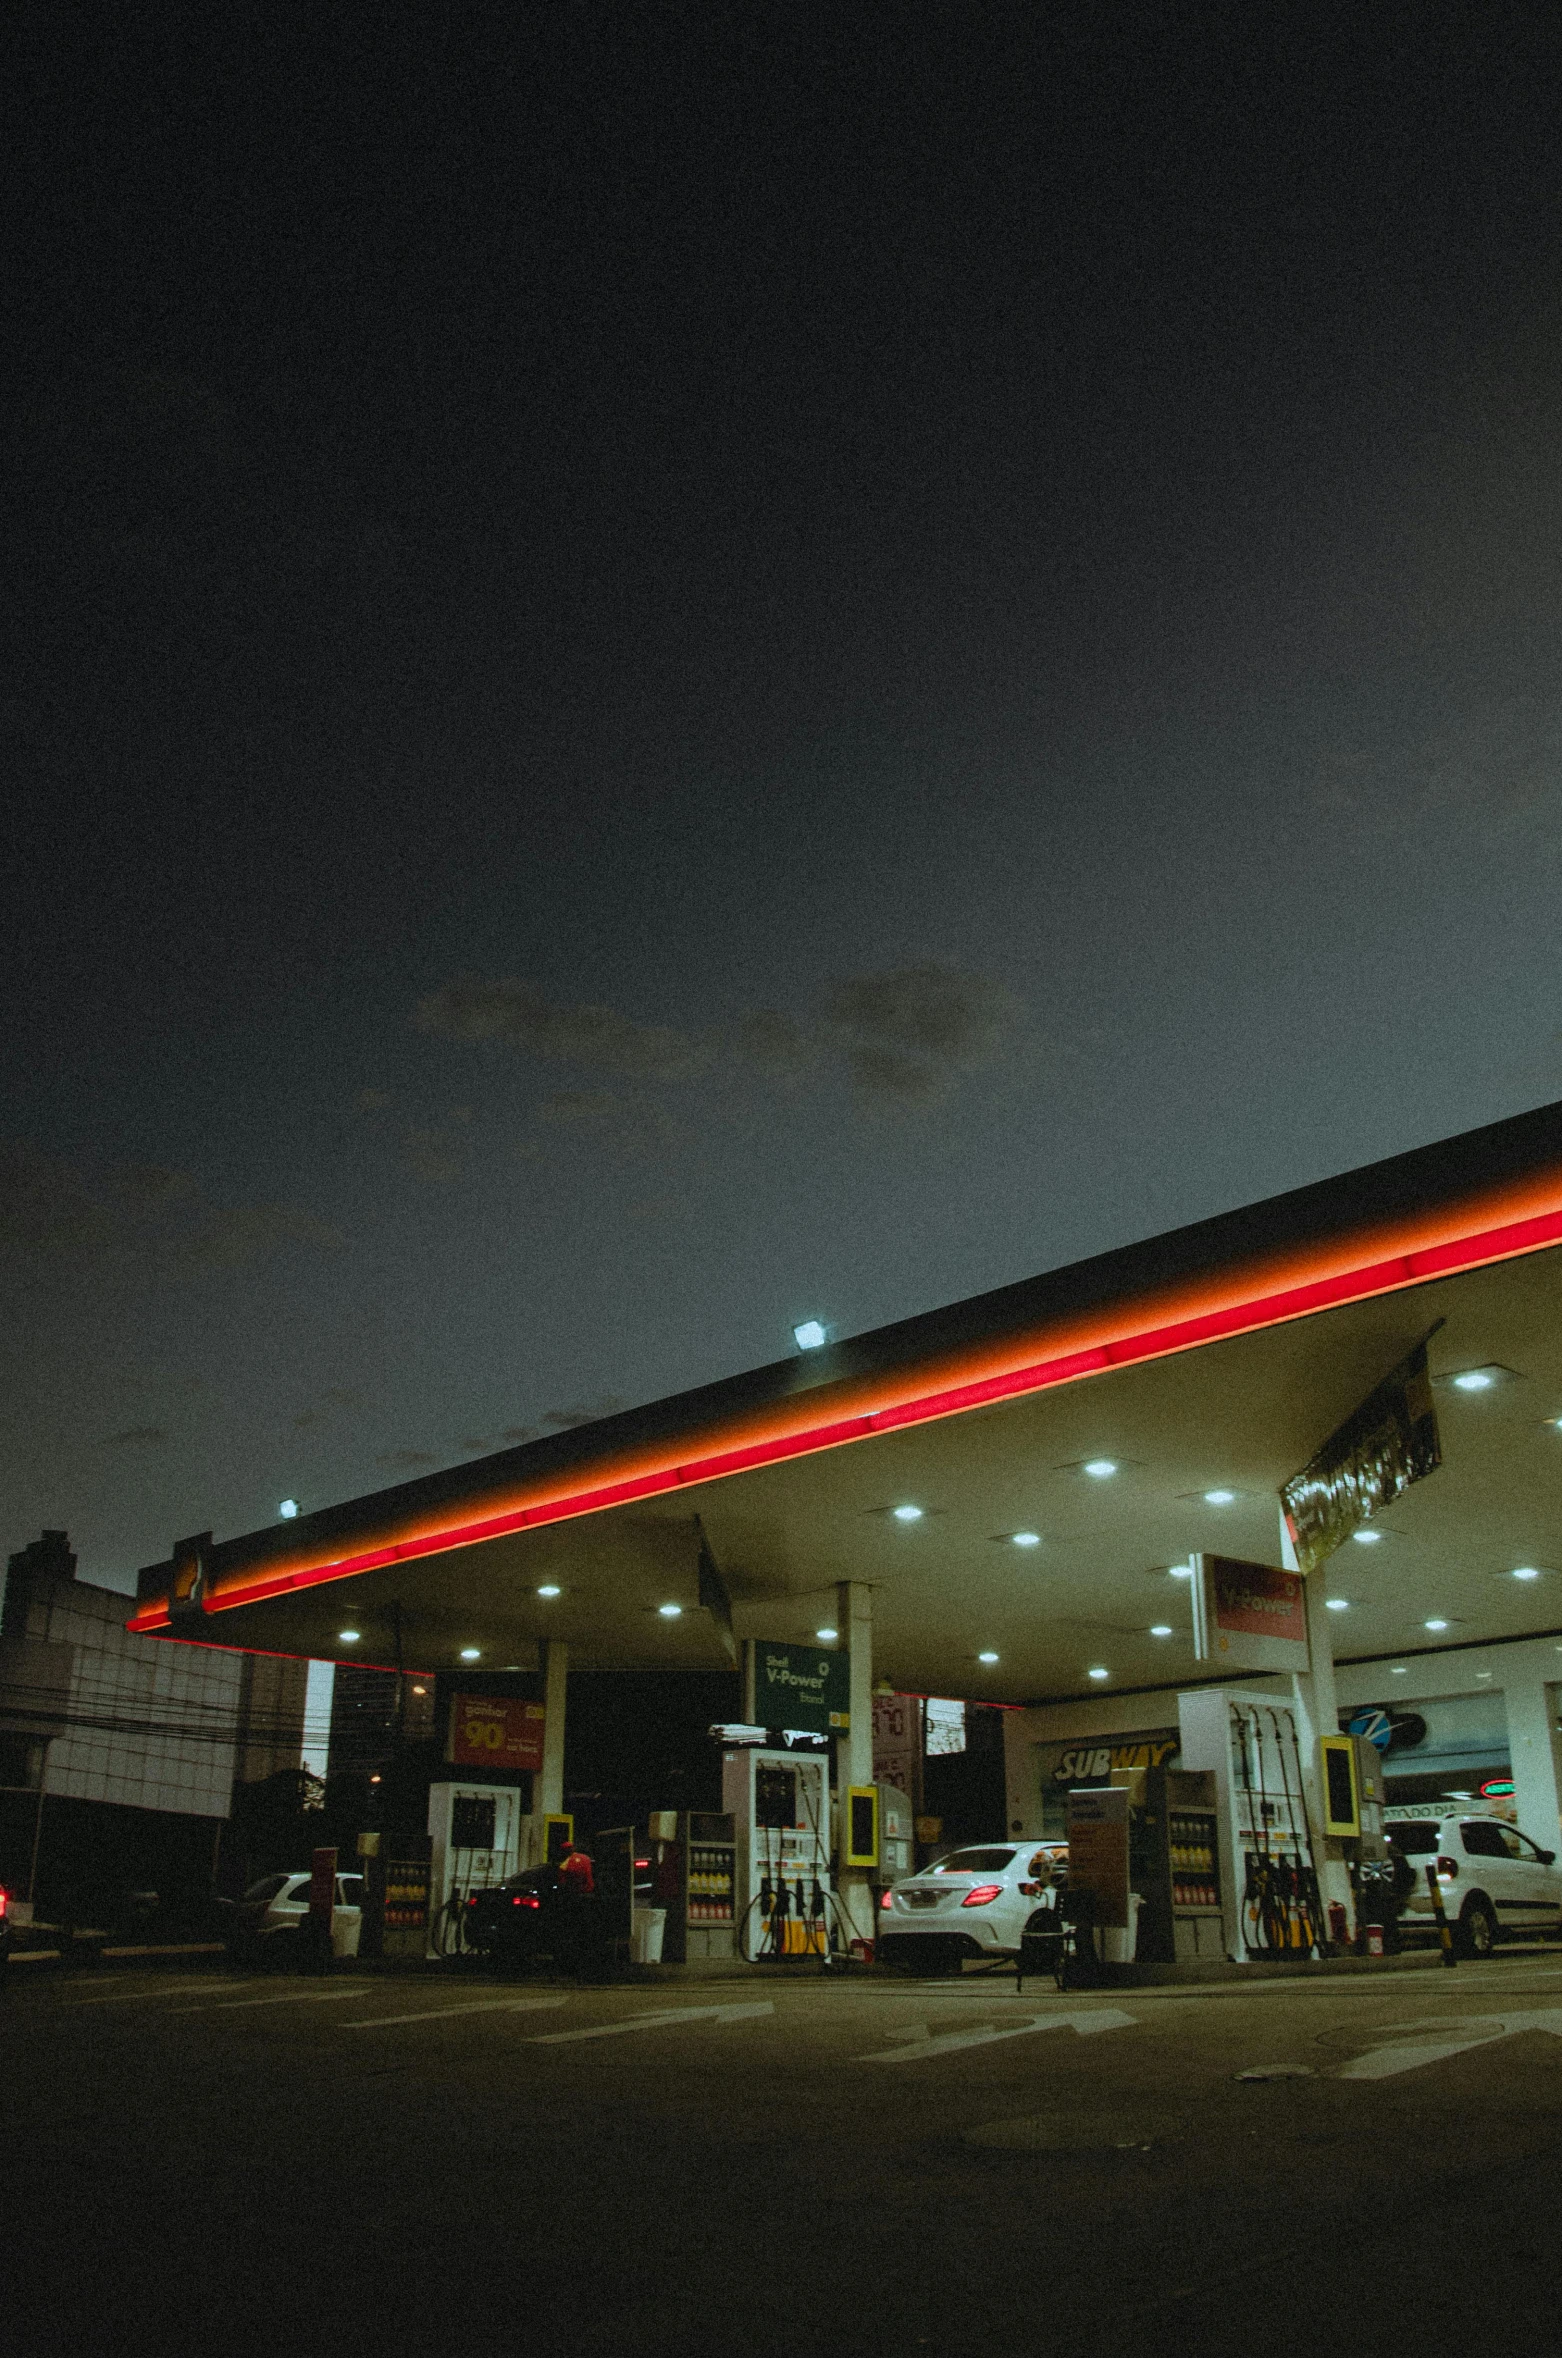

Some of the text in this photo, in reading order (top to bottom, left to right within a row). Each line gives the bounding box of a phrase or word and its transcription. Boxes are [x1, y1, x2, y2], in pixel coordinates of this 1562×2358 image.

[766, 1655, 789, 1668] Shell
[766, 1668, 825, 1689] V-Power
[465, 1720, 504, 1750] 90
[1054, 1741, 1177, 1781] SUBWAY
[1411, 1807, 1431, 1818] DO
[1435, 1805, 1457, 1816] DIA
